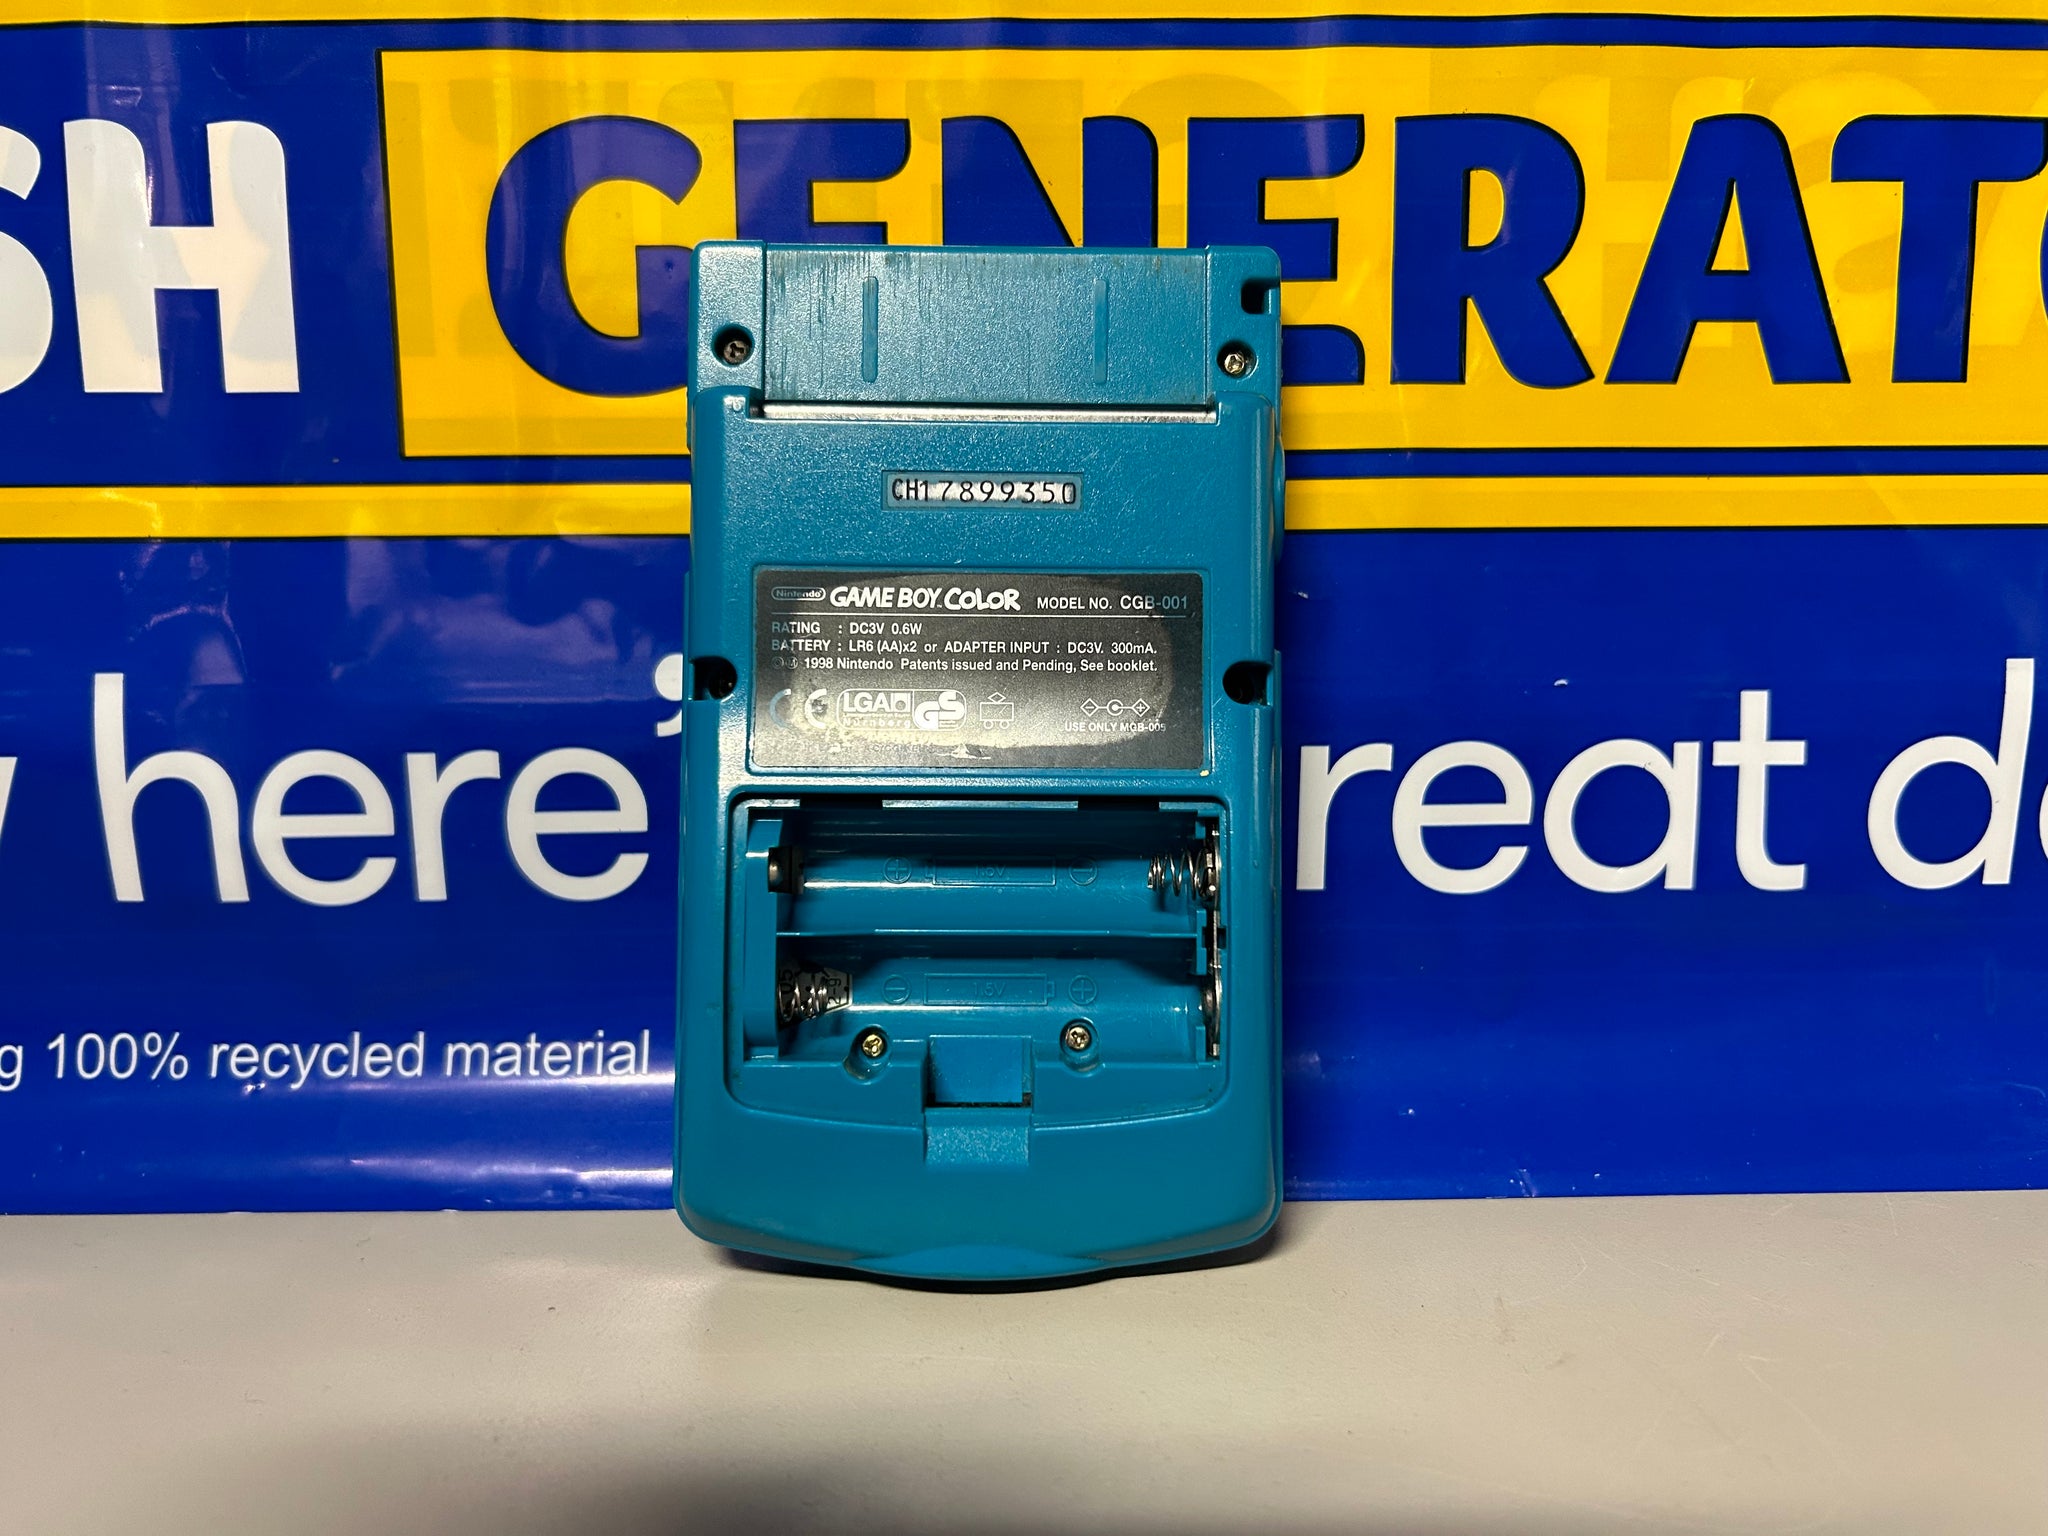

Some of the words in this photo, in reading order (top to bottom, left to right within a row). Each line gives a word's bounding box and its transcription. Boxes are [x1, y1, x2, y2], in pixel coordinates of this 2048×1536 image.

[892, 478, 1077, 504] CH17899350
[830, 586, 895, 608] GAME
[944, 587, 1021, 611] COLOR
[1037, 597, 1085, 609] MODEL
[1089, 597, 1113, 609] NO.
[1120, 595, 1187, 609] CGB-001
[771, 622, 821, 634] RATING
[849, 623, 885, 634] DC3V
[891, 623, 923, 634] 0.6W
[771, 639, 831, 651] BATTERY
[849, 640, 874, 652] LR6
[876, 640, 917, 654] (AA)x2
[924, 643, 938, 653] or
[944, 641, 1006, 653] ADAPTER
[1010, 642, 1050, 653] INPUT
[1111, 642, 1158, 654] 300mA.
[804, 658, 834, 669] 1998
[837, 658, 894, 670] Nintendo
[901, 659, 949, 670] Patents
[951, 658, 992, 671] issued
[996, 659, 1019, 671] and
[1022, 659, 1077, 673] Pending,
[1080, 660, 1104, 671] See
[1107, 659, 1158, 671] booklet.
[843, 693, 891, 713] LGA
[1065, 721, 1086, 732] USE
[1088, 721, 1118, 732] ONLY
[1119, 721, 1167, 733] MGB-005
[1867, 657, 2048, 890] d
[974, 982, 1007, 997] 1.5V
[47, 1030, 189, 1081] 100%
[209, 1030, 424, 1089] recycled
[444, 1029, 650, 1077] material
